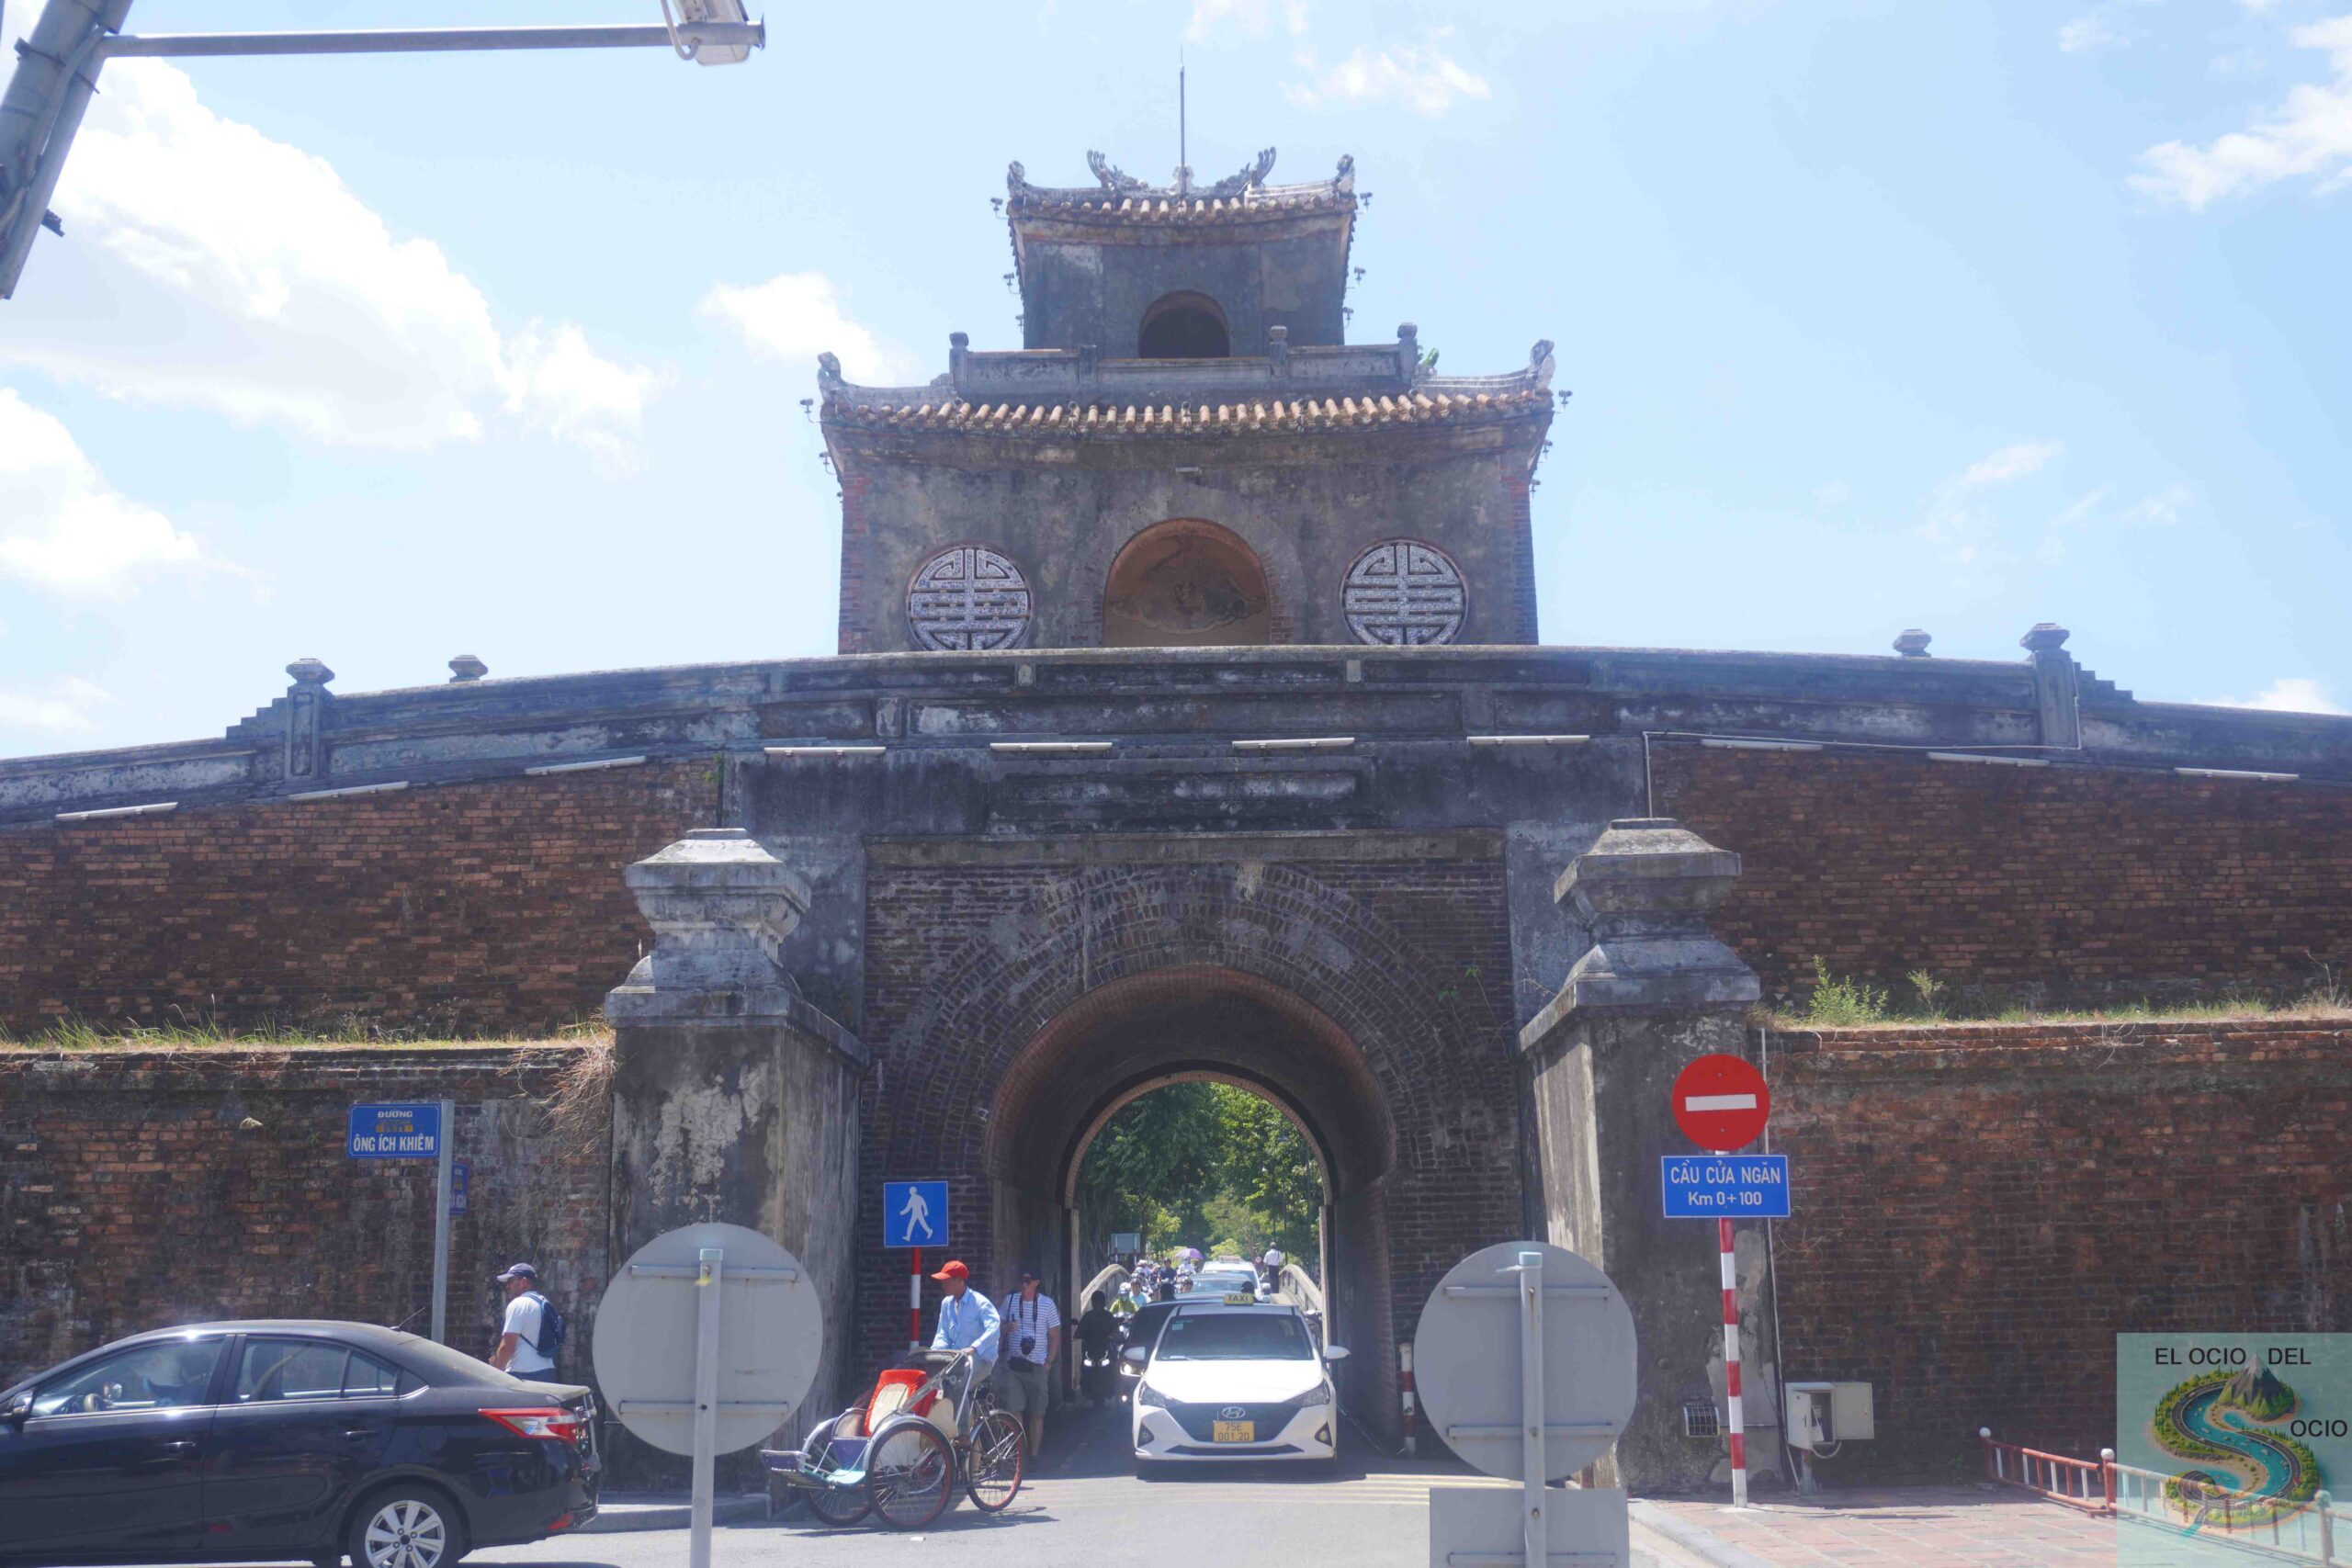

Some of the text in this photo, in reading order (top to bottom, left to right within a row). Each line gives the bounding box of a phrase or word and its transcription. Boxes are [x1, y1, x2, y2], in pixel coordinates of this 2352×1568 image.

[378, 1109, 413, 1119] ĐƯỜNG
[353, 1133, 435, 1152] ÔNG ÍCH KHIÊM
[1670, 1159, 1781, 1184] CẦU CỬA NGĂN
[1688, 1191, 1713, 1206] Km
[1227, 1293, 1250, 1303] TAXI
